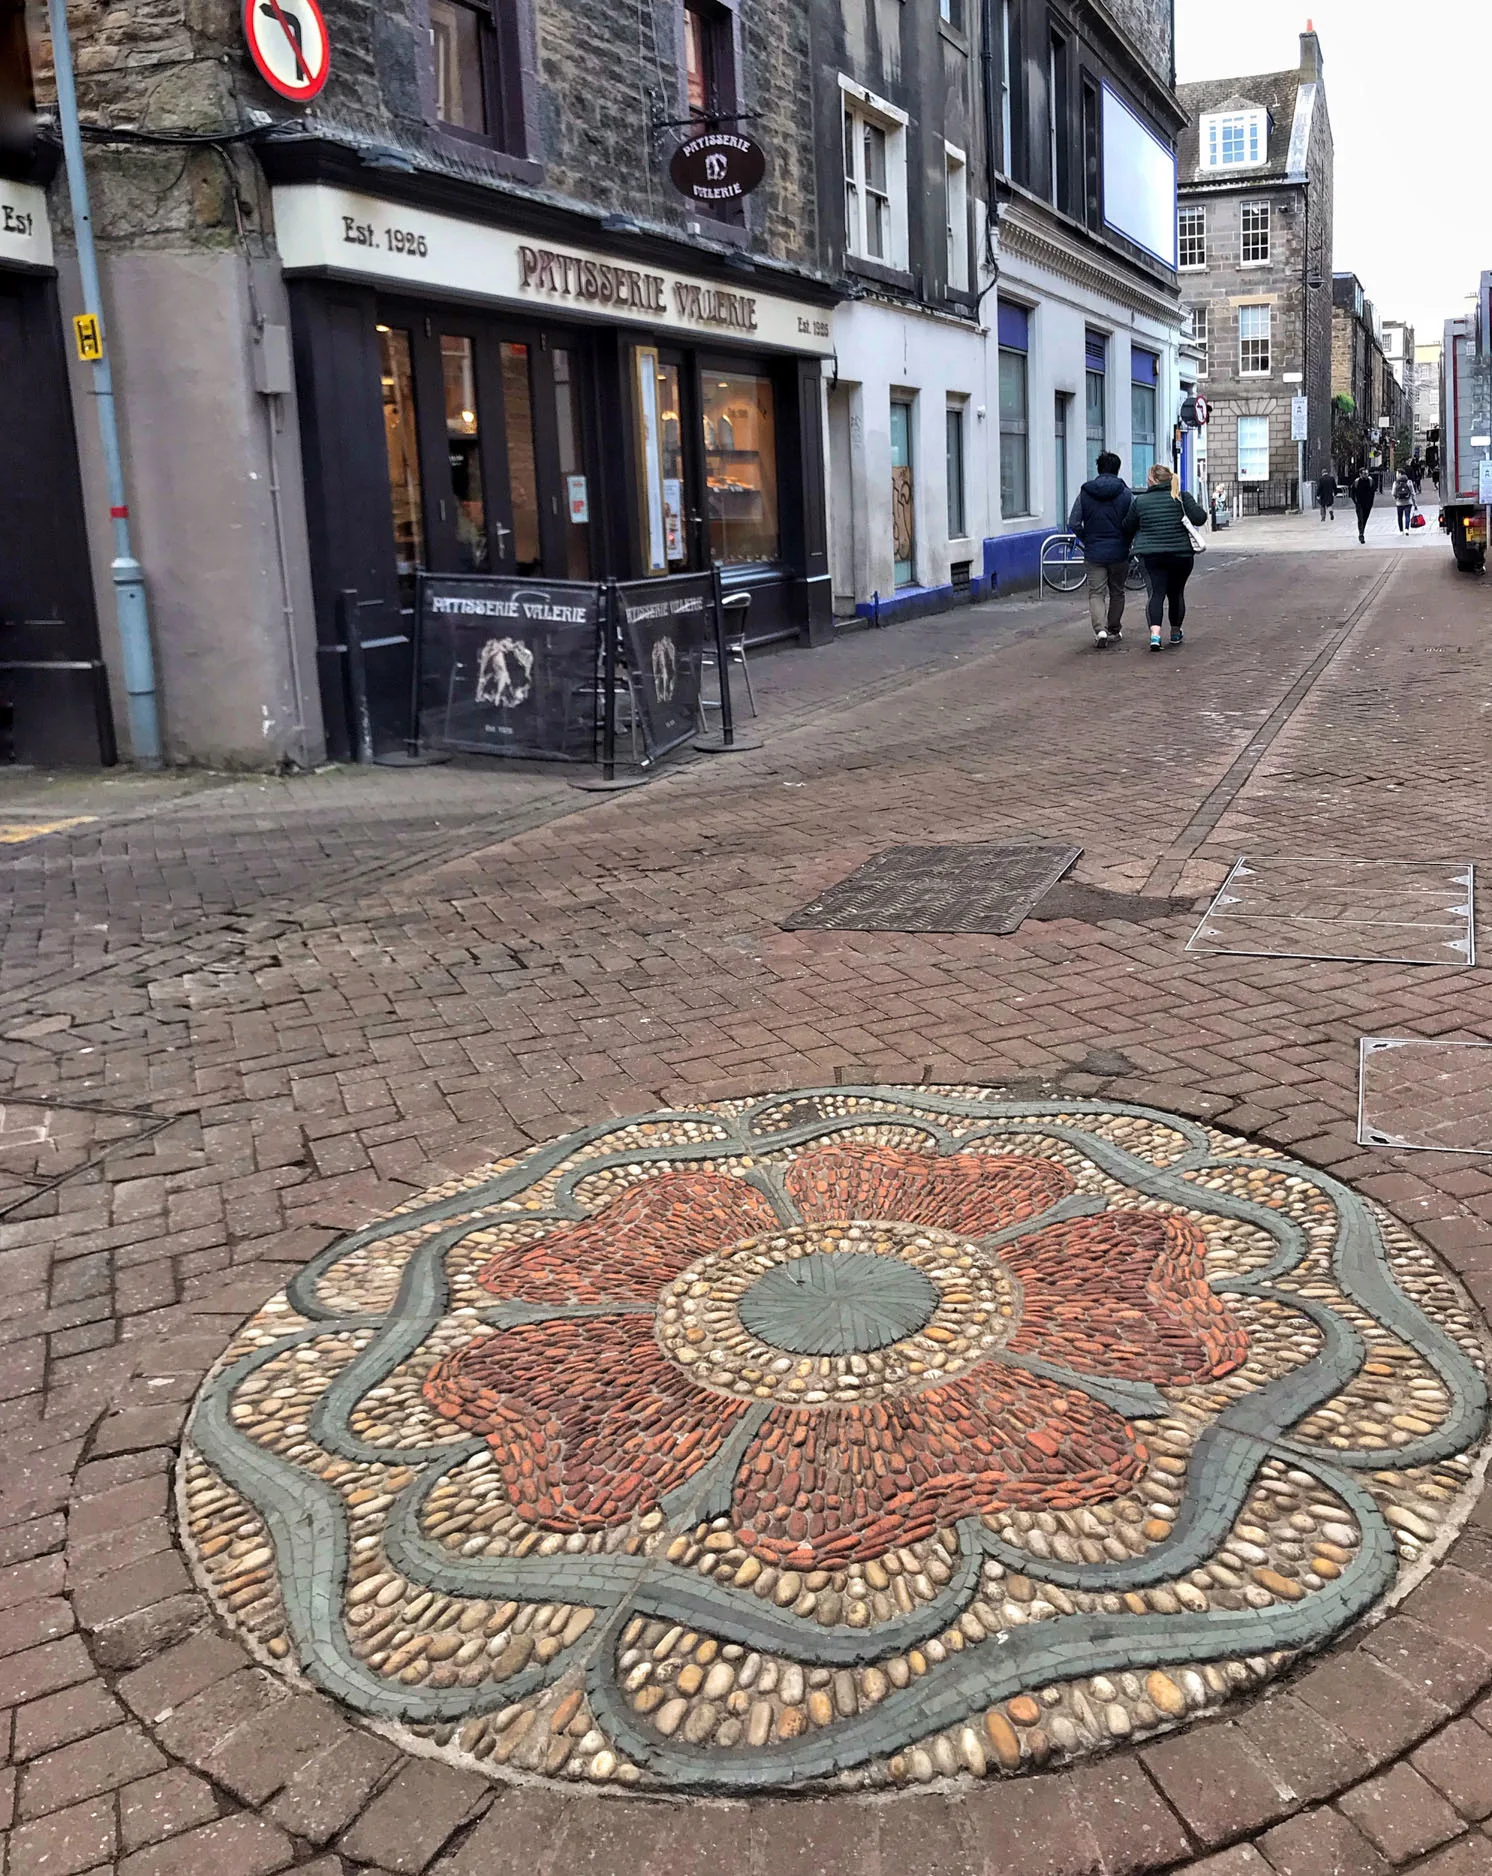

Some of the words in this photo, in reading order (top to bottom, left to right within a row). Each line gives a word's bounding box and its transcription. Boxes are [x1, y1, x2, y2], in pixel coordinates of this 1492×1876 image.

[682, 134, 751, 157] PATISSERIE
[693, 182, 742, 199] VALERIE
[342, 216, 380, 248] Est.
[384, 228, 428, 258] 1926
[518, 246, 667, 313] PATISSERIE
[673, 281, 758, 330] VALERIE
[432, 596, 519, 618] PATISSERIE
[523, 604, 587, 623] VALERIE
